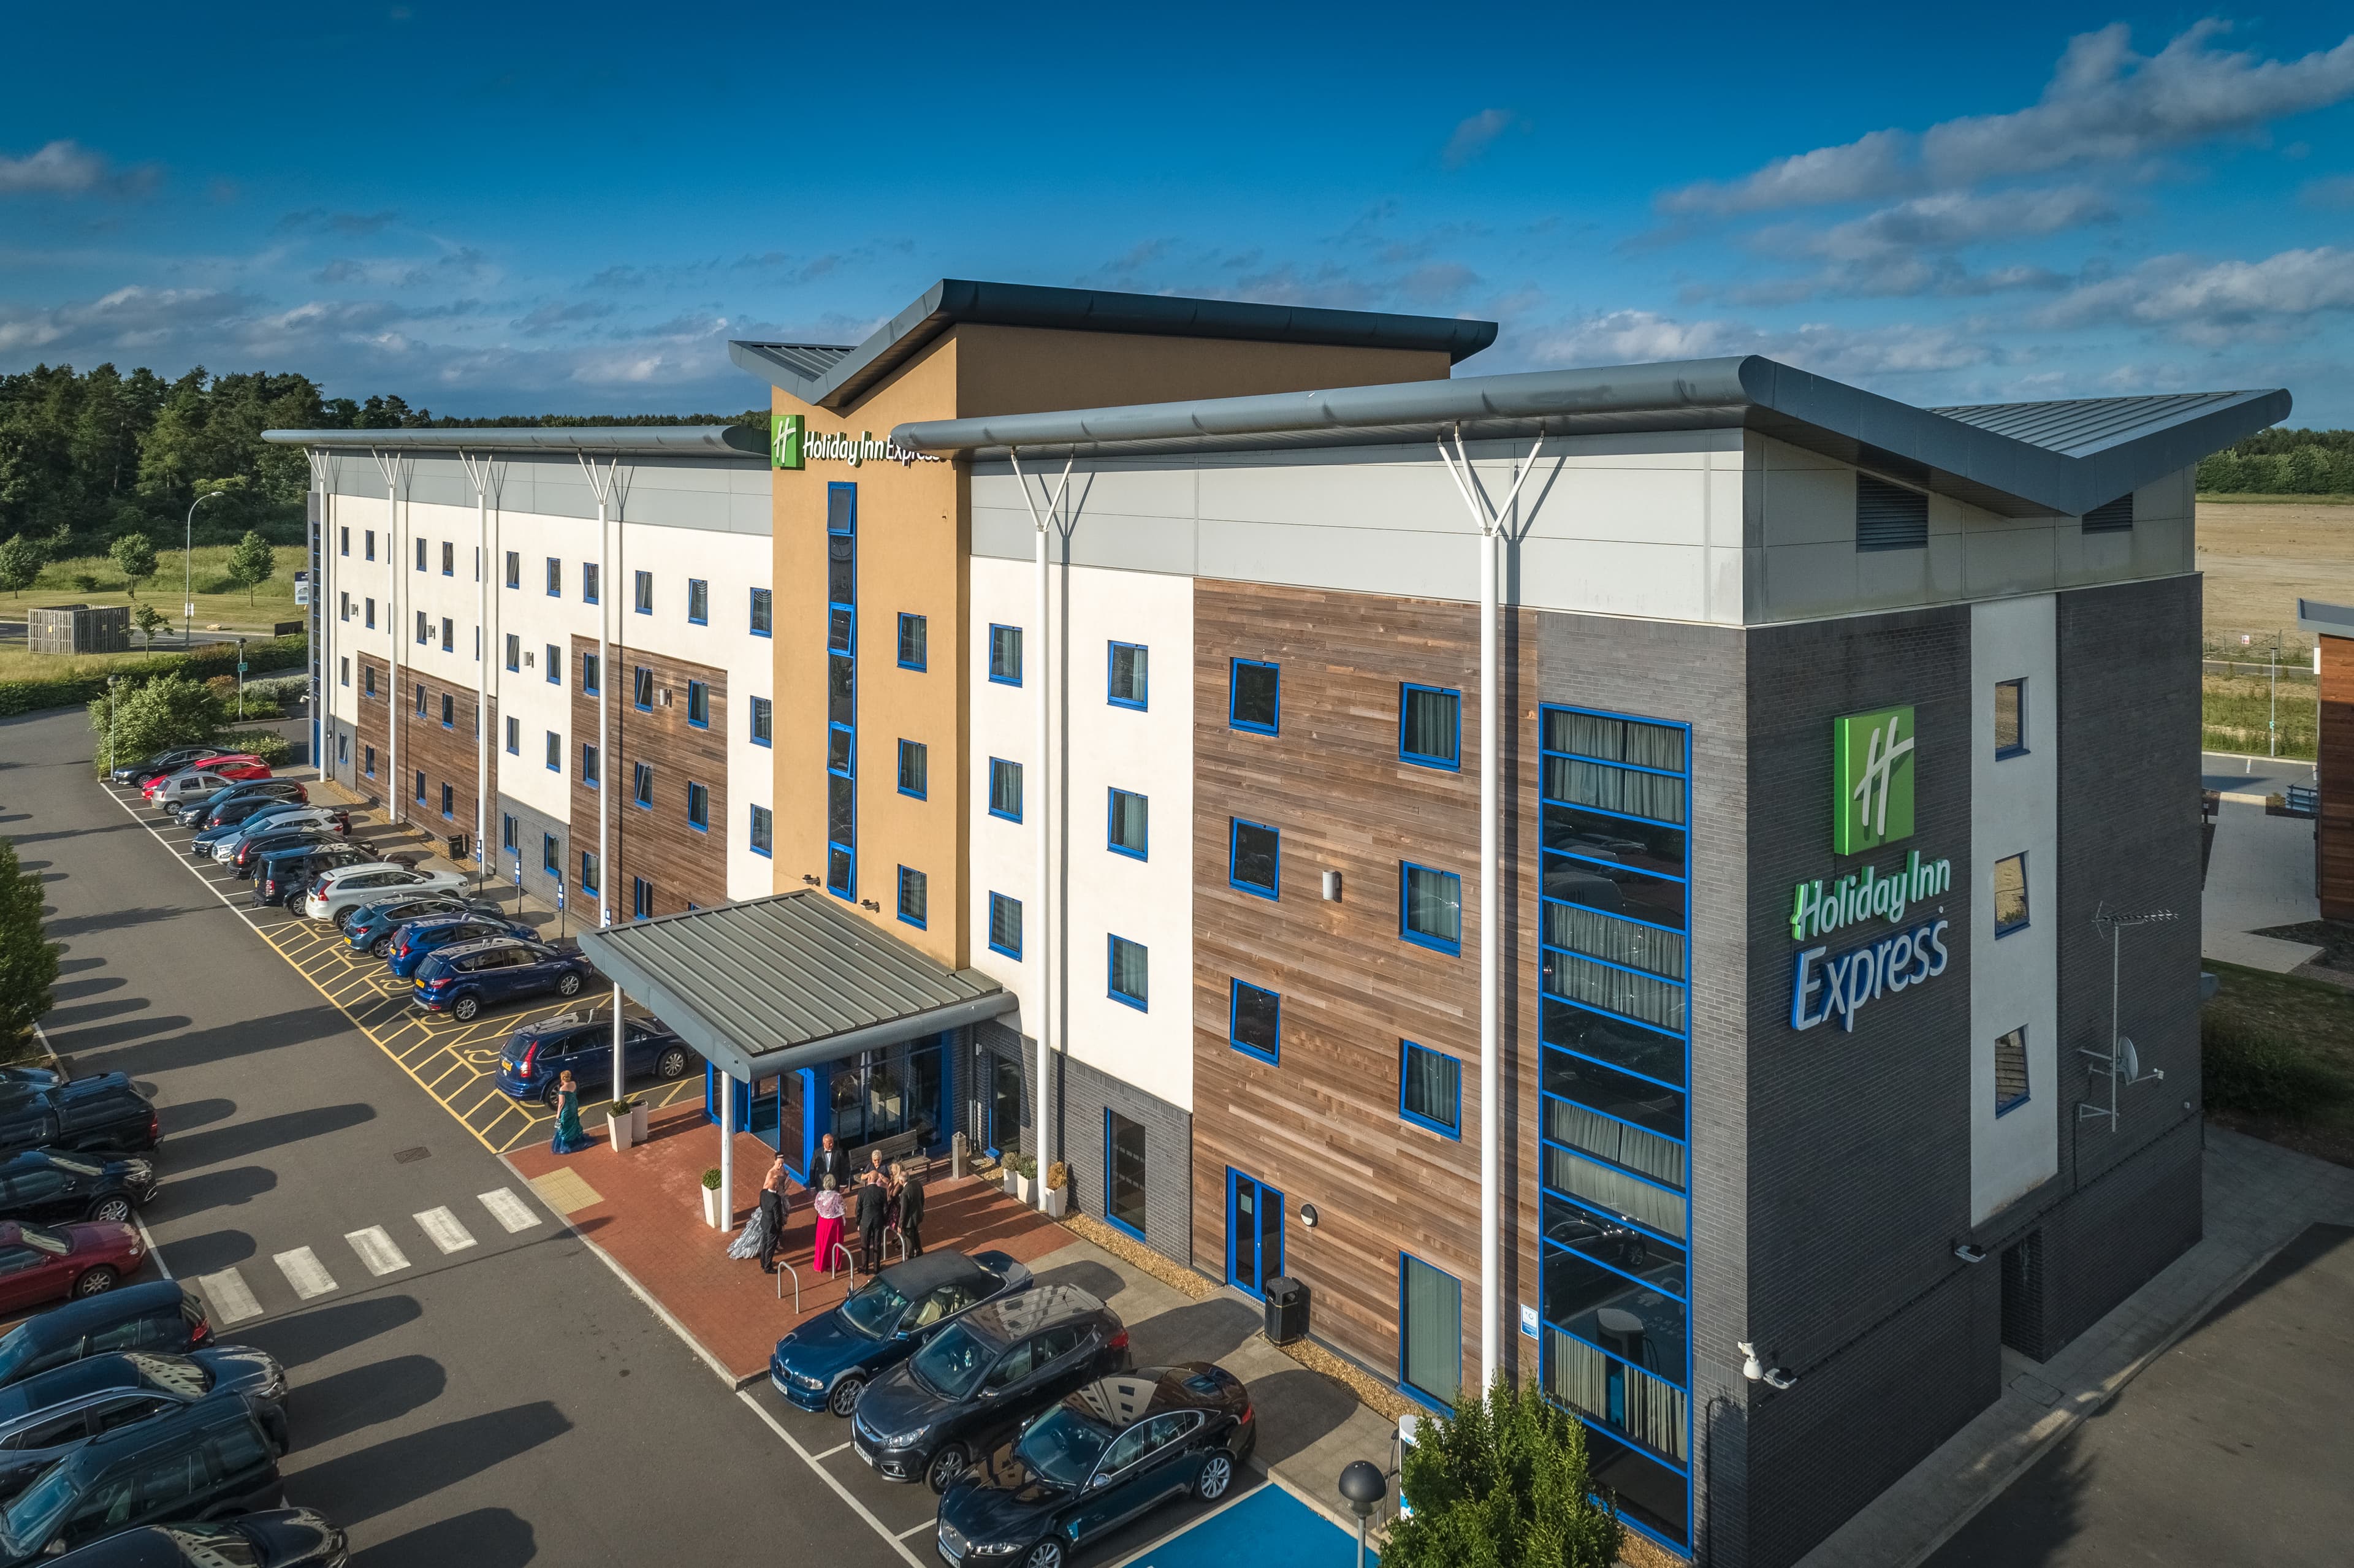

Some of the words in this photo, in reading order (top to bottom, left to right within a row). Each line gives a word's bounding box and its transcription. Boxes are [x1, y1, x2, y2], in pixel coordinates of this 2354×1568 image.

[803, 431, 858, 466] Holiday
[860, 430, 883, 459] Inn
[886, 435, 940, 466] Expr
[1790, 866, 1906, 941] Holiday
[1908, 850, 1951, 903] Inn
[1790, 920, 1949, 1032] Express
